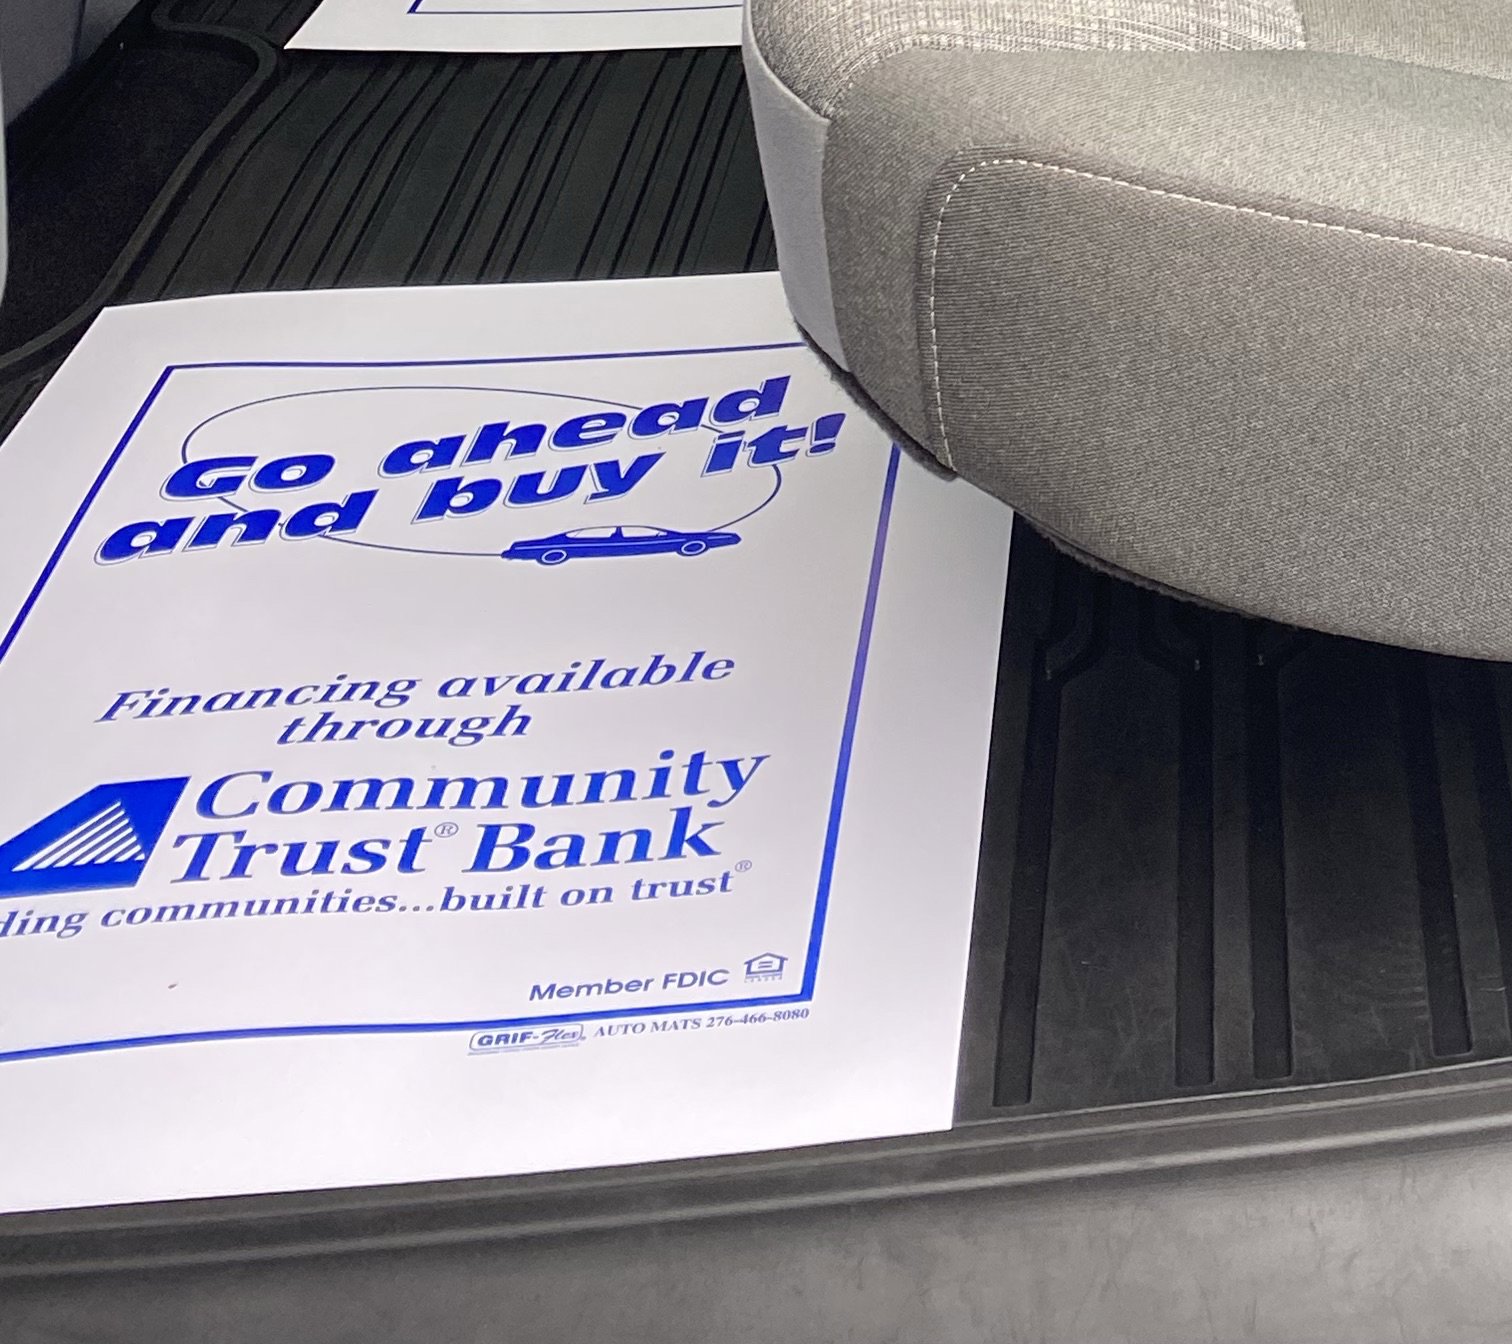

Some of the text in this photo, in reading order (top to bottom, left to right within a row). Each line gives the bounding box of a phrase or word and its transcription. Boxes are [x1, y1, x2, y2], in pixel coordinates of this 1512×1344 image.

[159, 375, 793, 501] Go ahead
[93, 412, 848, 566] and buy it!
[93, 646, 740, 725] Financing available
[277, 703, 533, 748] through
[196, 749, 773, 820] Community
[461, 805, 726, 874] Bank
[559, 885, 614, 907] on
[529, 968, 732, 1002] Member FDIC
[594, 1021, 646, 1038] AUTO
[650, 1017, 702, 1033] MATS
[706, 1008, 810, 1029] 276-466-8080
